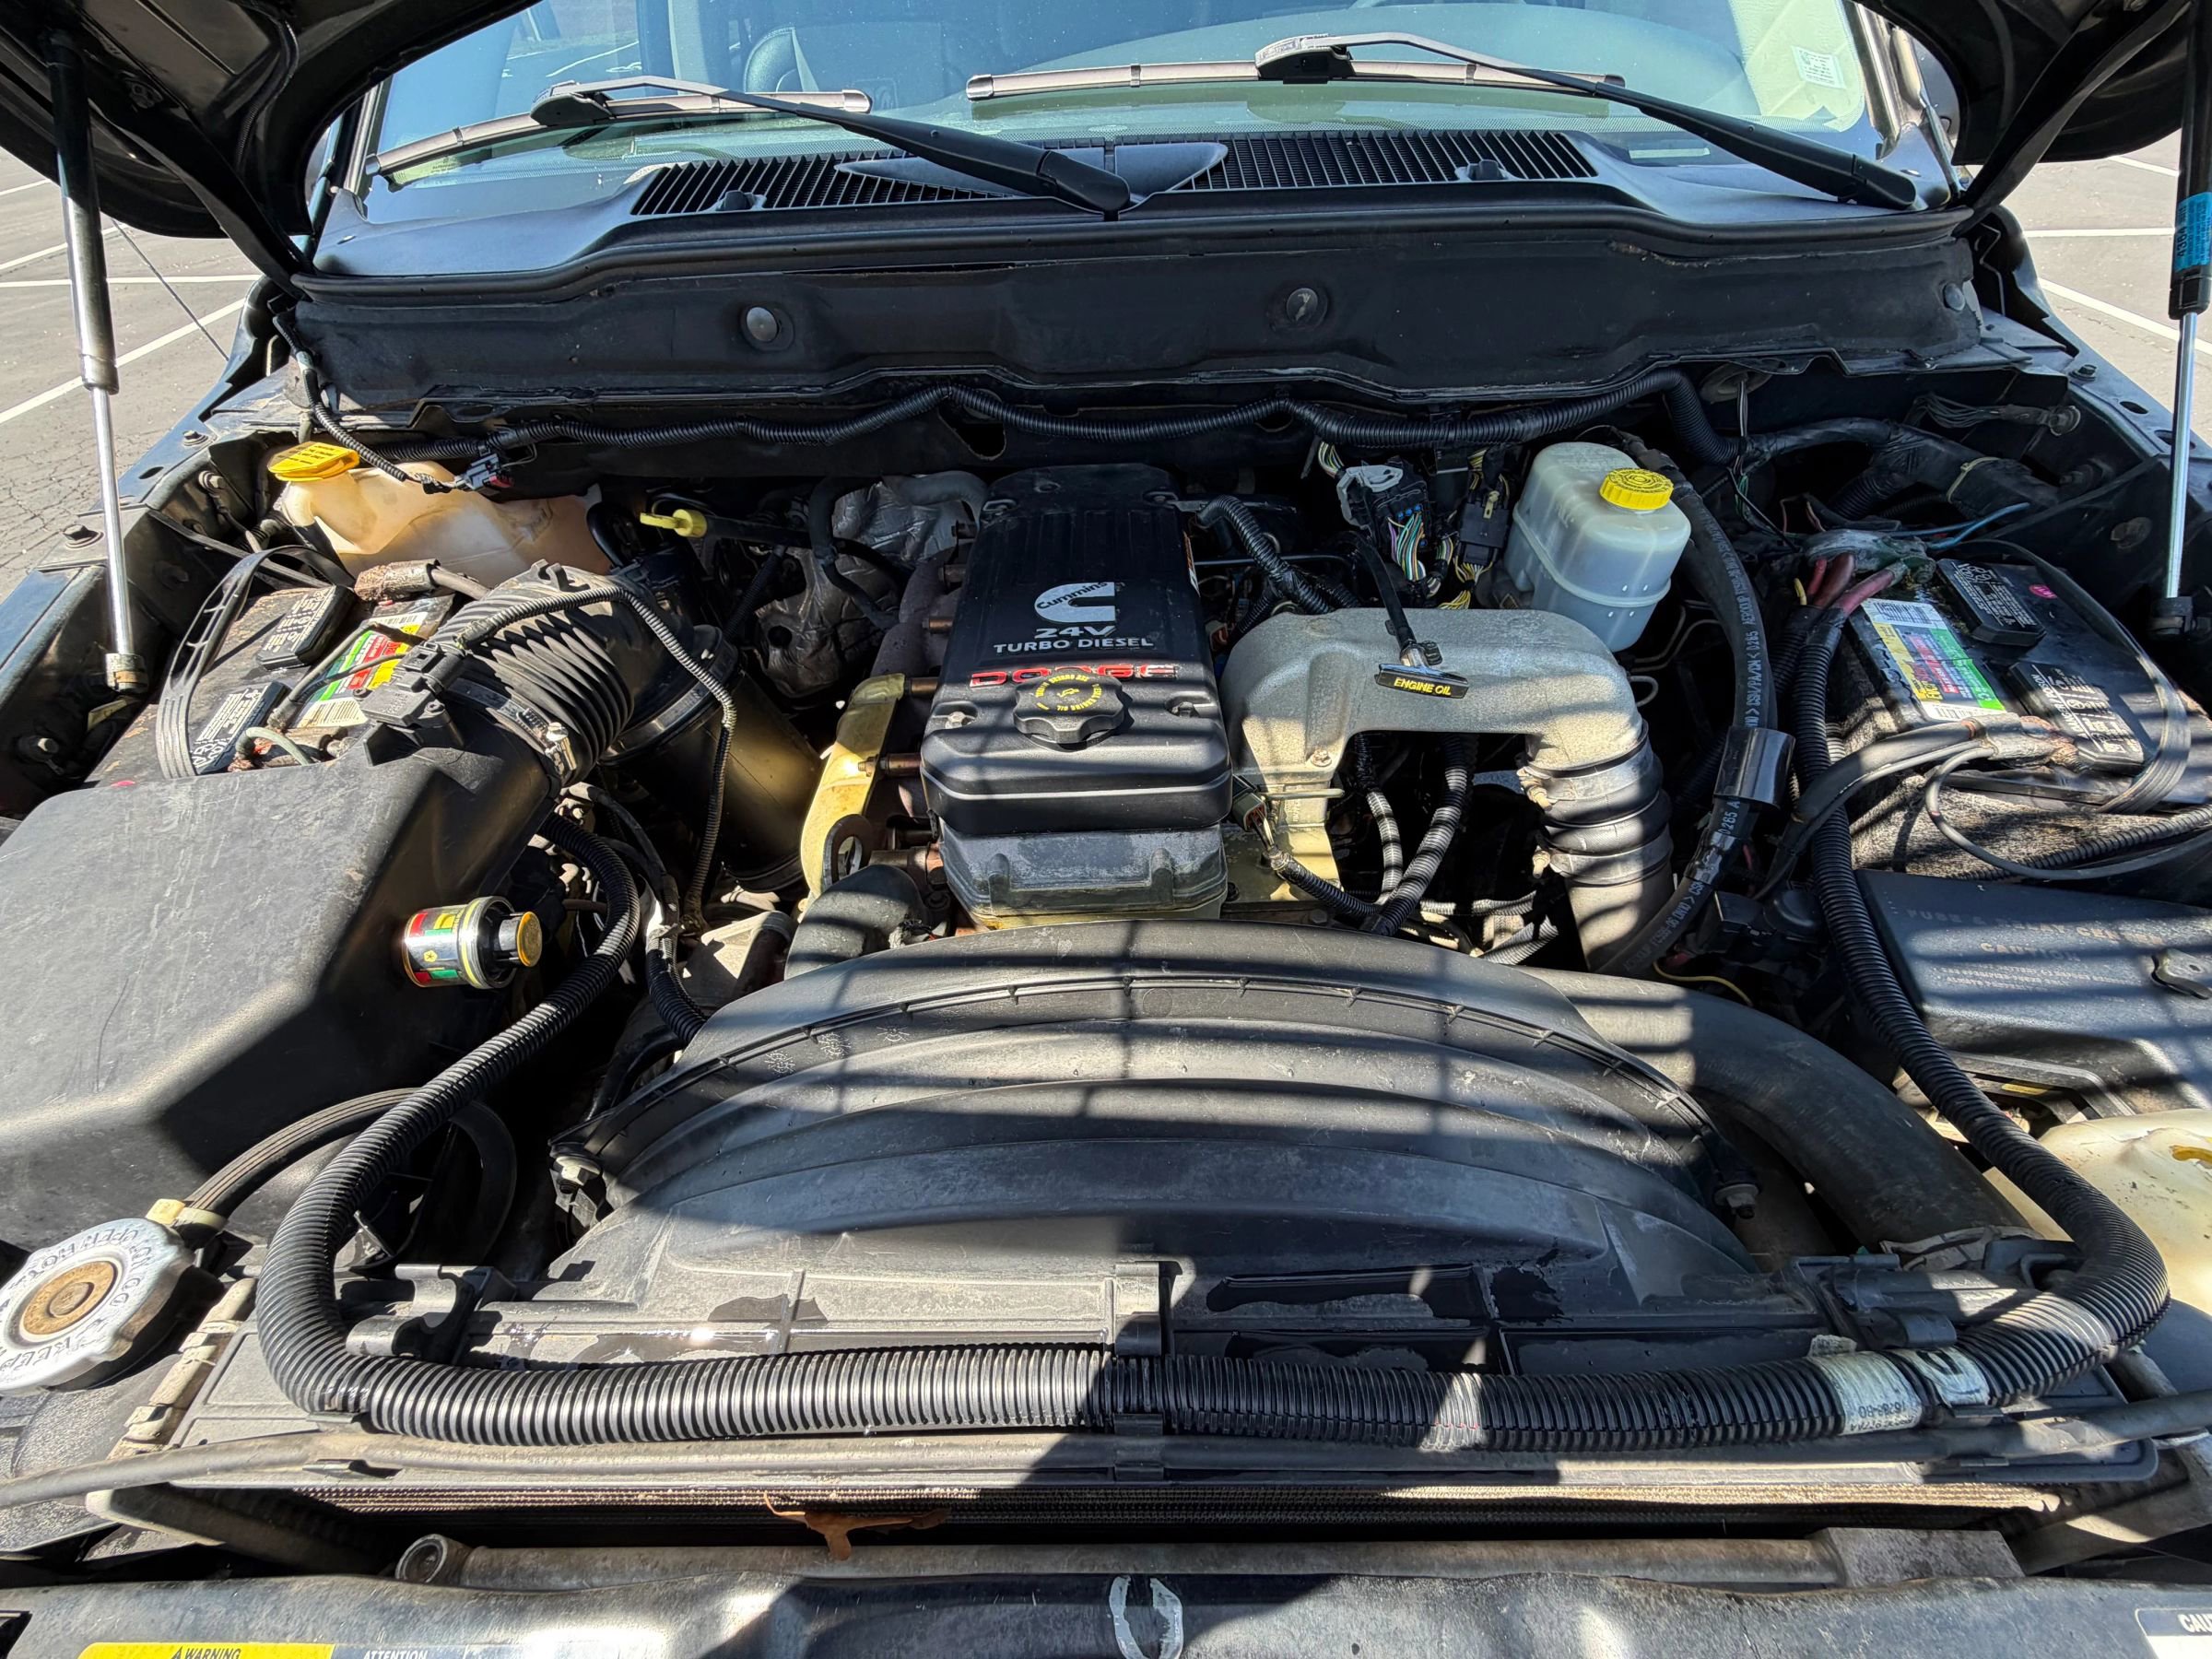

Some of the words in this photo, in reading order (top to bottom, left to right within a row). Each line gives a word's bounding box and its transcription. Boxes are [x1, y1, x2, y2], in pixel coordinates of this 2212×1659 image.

[1036, 582, 1109, 610] Cummins
[1034, 625, 1117, 640] 24V
[994, 639, 1070, 654] TURBO
[1078, 637, 1154, 649] DIESEL
[970, 664, 1180, 690] DOGE
[1394, 677, 1435, 693] ENGINE
[1434, 684, 1452, 696] OIL
